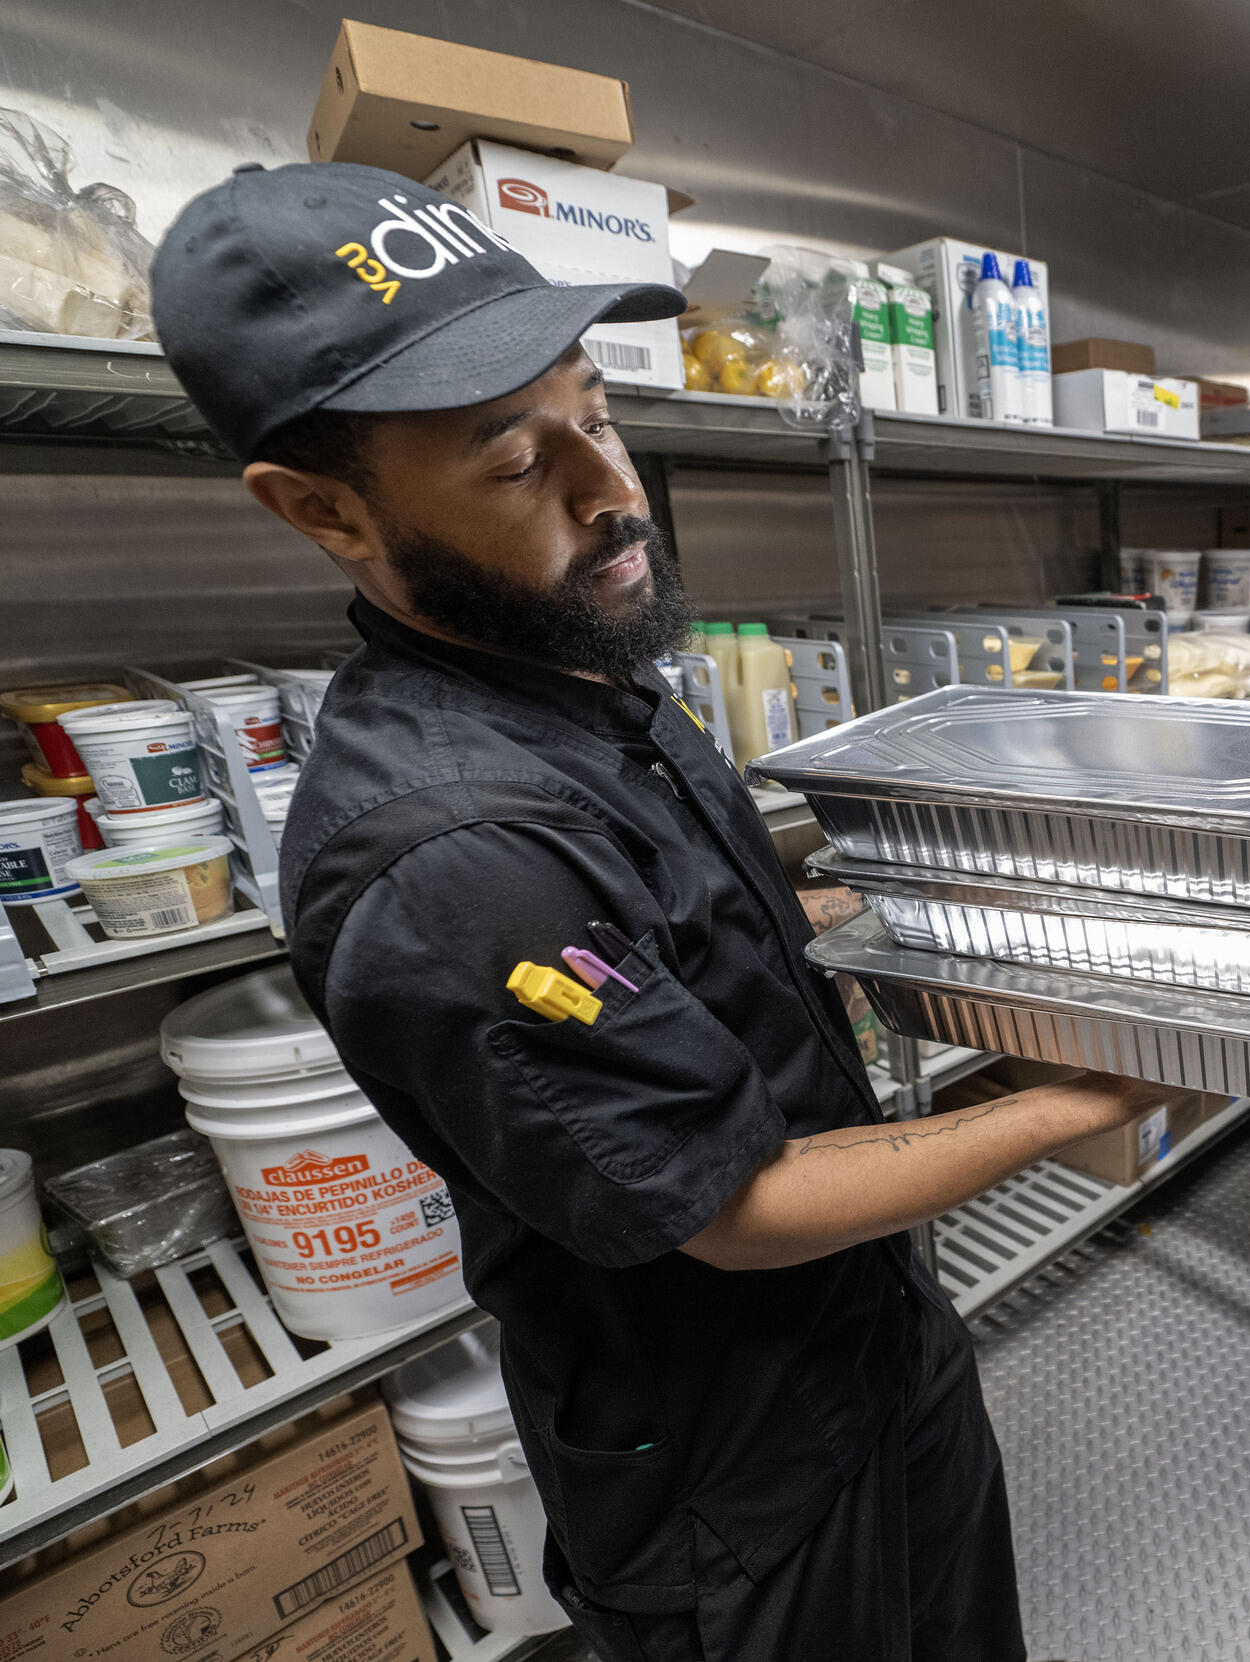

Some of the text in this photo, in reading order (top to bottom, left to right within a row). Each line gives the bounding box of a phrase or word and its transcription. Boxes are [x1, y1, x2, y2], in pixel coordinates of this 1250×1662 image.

[371, 194, 511, 279] din
[555, 201, 655, 243] MINOR'S
[335, 242, 401, 305] vcu
[268, 1160, 364, 1185] claussen
[278, 1193, 367, 1217] ENCURTIDO
[372, 1169, 438, 1201] KOSHER
[294, 1187, 316, 1202] DE
[317, 1168, 403, 1199] PEPINILLO
[291, 1219, 381, 1259] 9195
[389, 1219, 419, 1235] COUNT
[308, 1256, 358, 1272] SIEMPRE
[360, 1227, 444, 1263] REFRIGERADO
[296, 1272, 316, 1286] NO
[319, 1258, 405, 1285] CONGELAR
[298, 1519, 338, 1546] CÍTRICO
[61, 1531, 183, 1633] Abbotsford
[187, 1520, 260, 1543] Farms
[122, 1630, 139, 1642] are
[160, 1598, 199, 1621] roaming
[200, 1582, 226, 1599] inside
